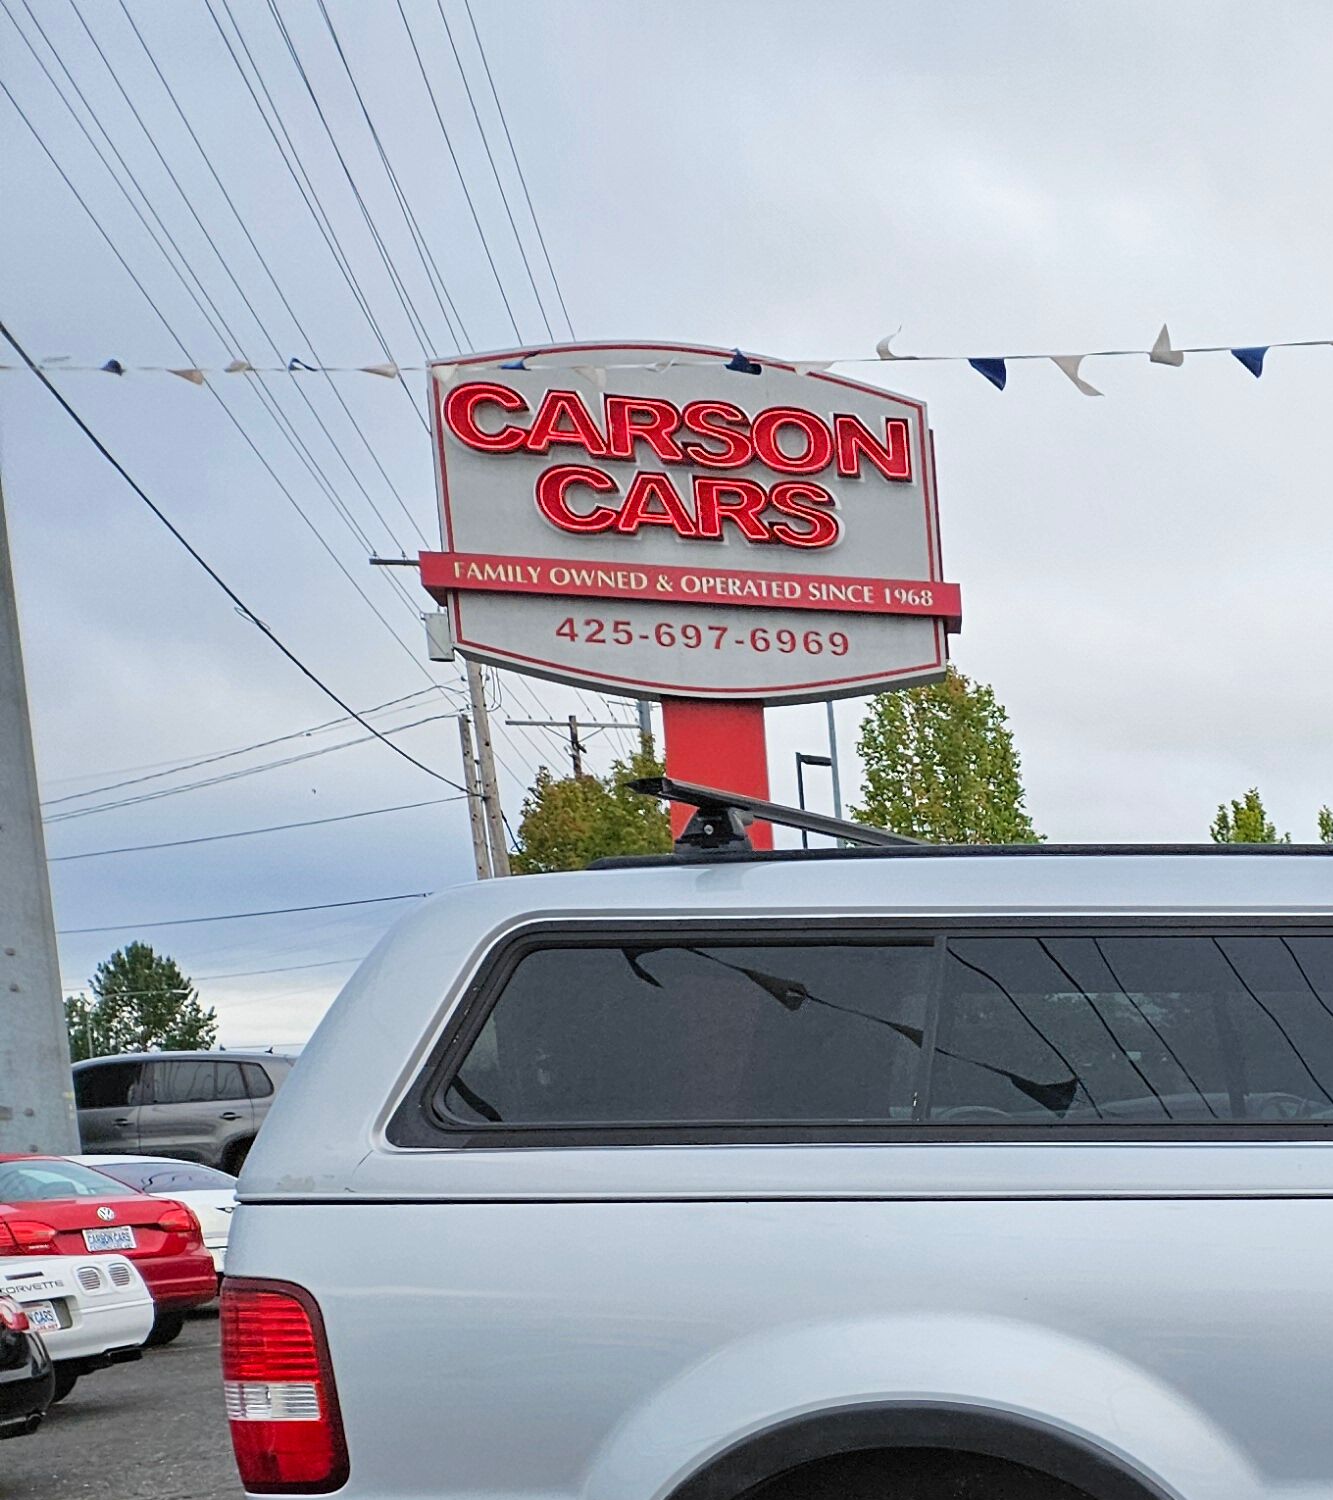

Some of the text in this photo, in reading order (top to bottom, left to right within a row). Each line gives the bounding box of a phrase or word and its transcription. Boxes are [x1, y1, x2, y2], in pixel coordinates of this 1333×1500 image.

[443, 381, 912, 482] CARSON
[535, 463, 840, 549] CARS
[454, 561, 934, 607] FAMILY OWNED & OPERATED SINCE 1968
[555, 616, 849, 656] 425-697-6969
[34, 1310, 54, 1324] CARS
